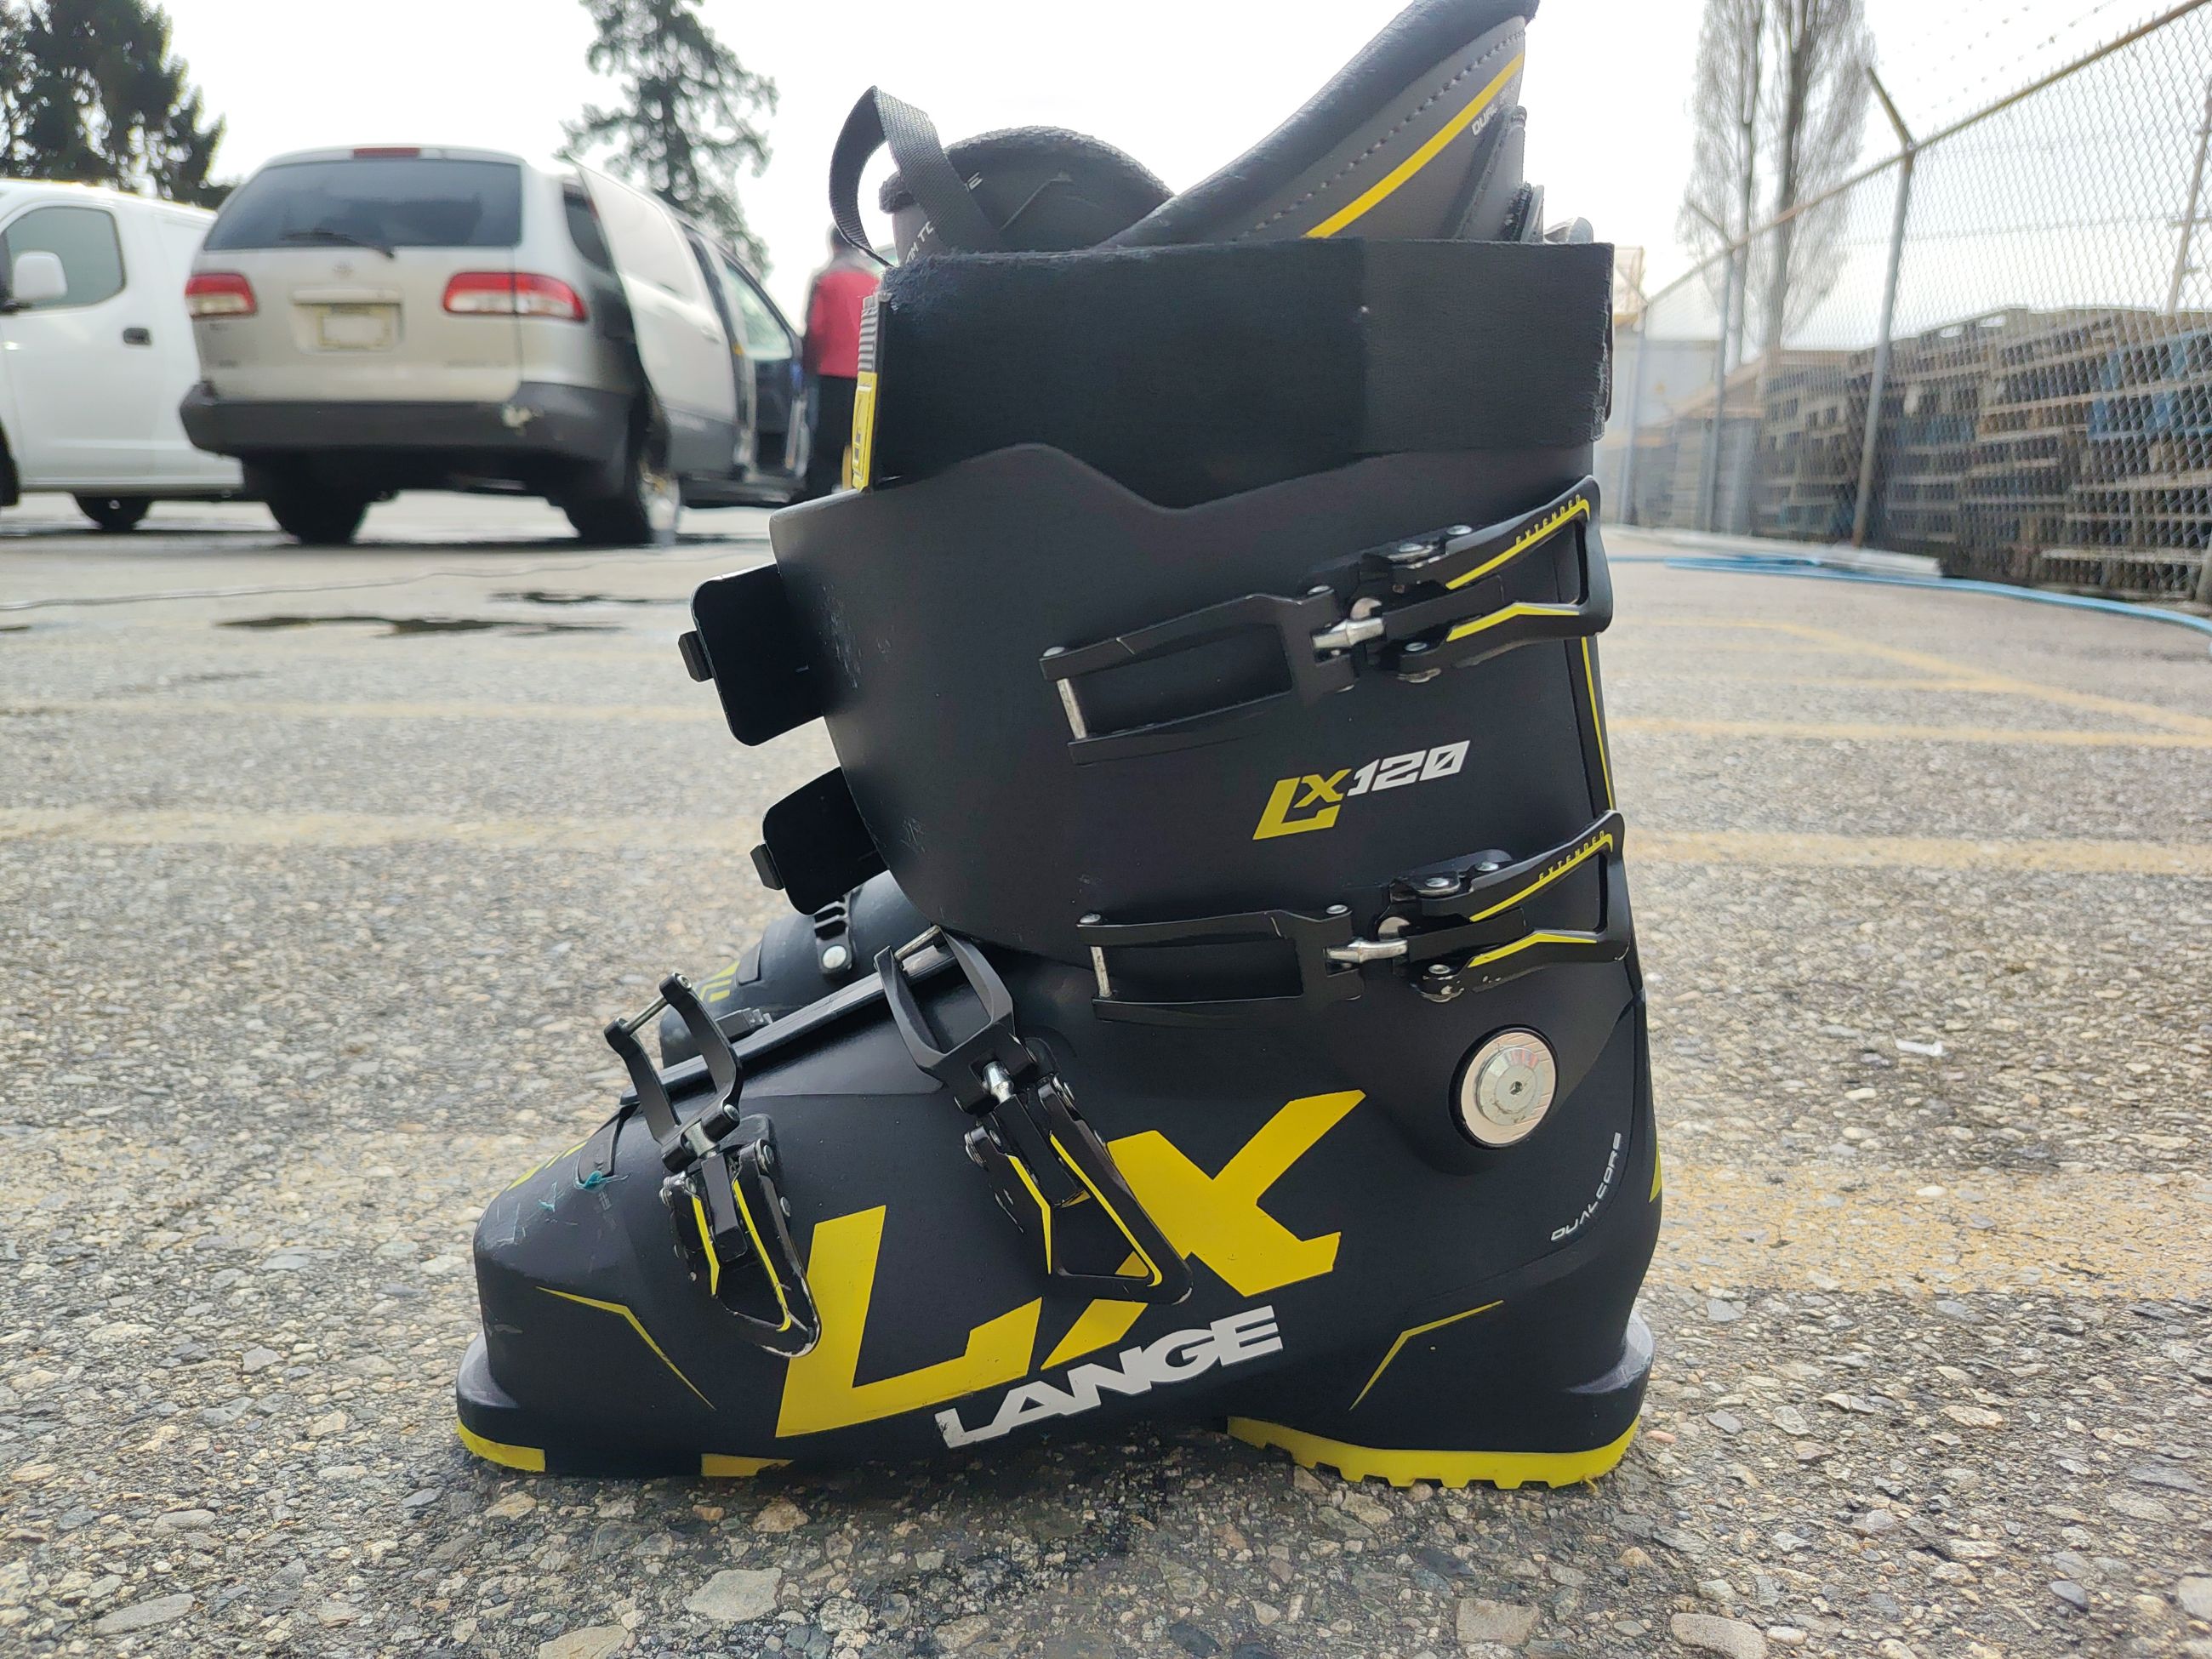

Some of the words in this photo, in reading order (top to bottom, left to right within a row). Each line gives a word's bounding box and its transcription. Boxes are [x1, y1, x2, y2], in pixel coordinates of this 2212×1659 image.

[1515, 493, 1581, 545] EXTENDED
[1538, 830, 1605, 881] EXTENDED
[934, 1305, 1283, 1449] LANGE
